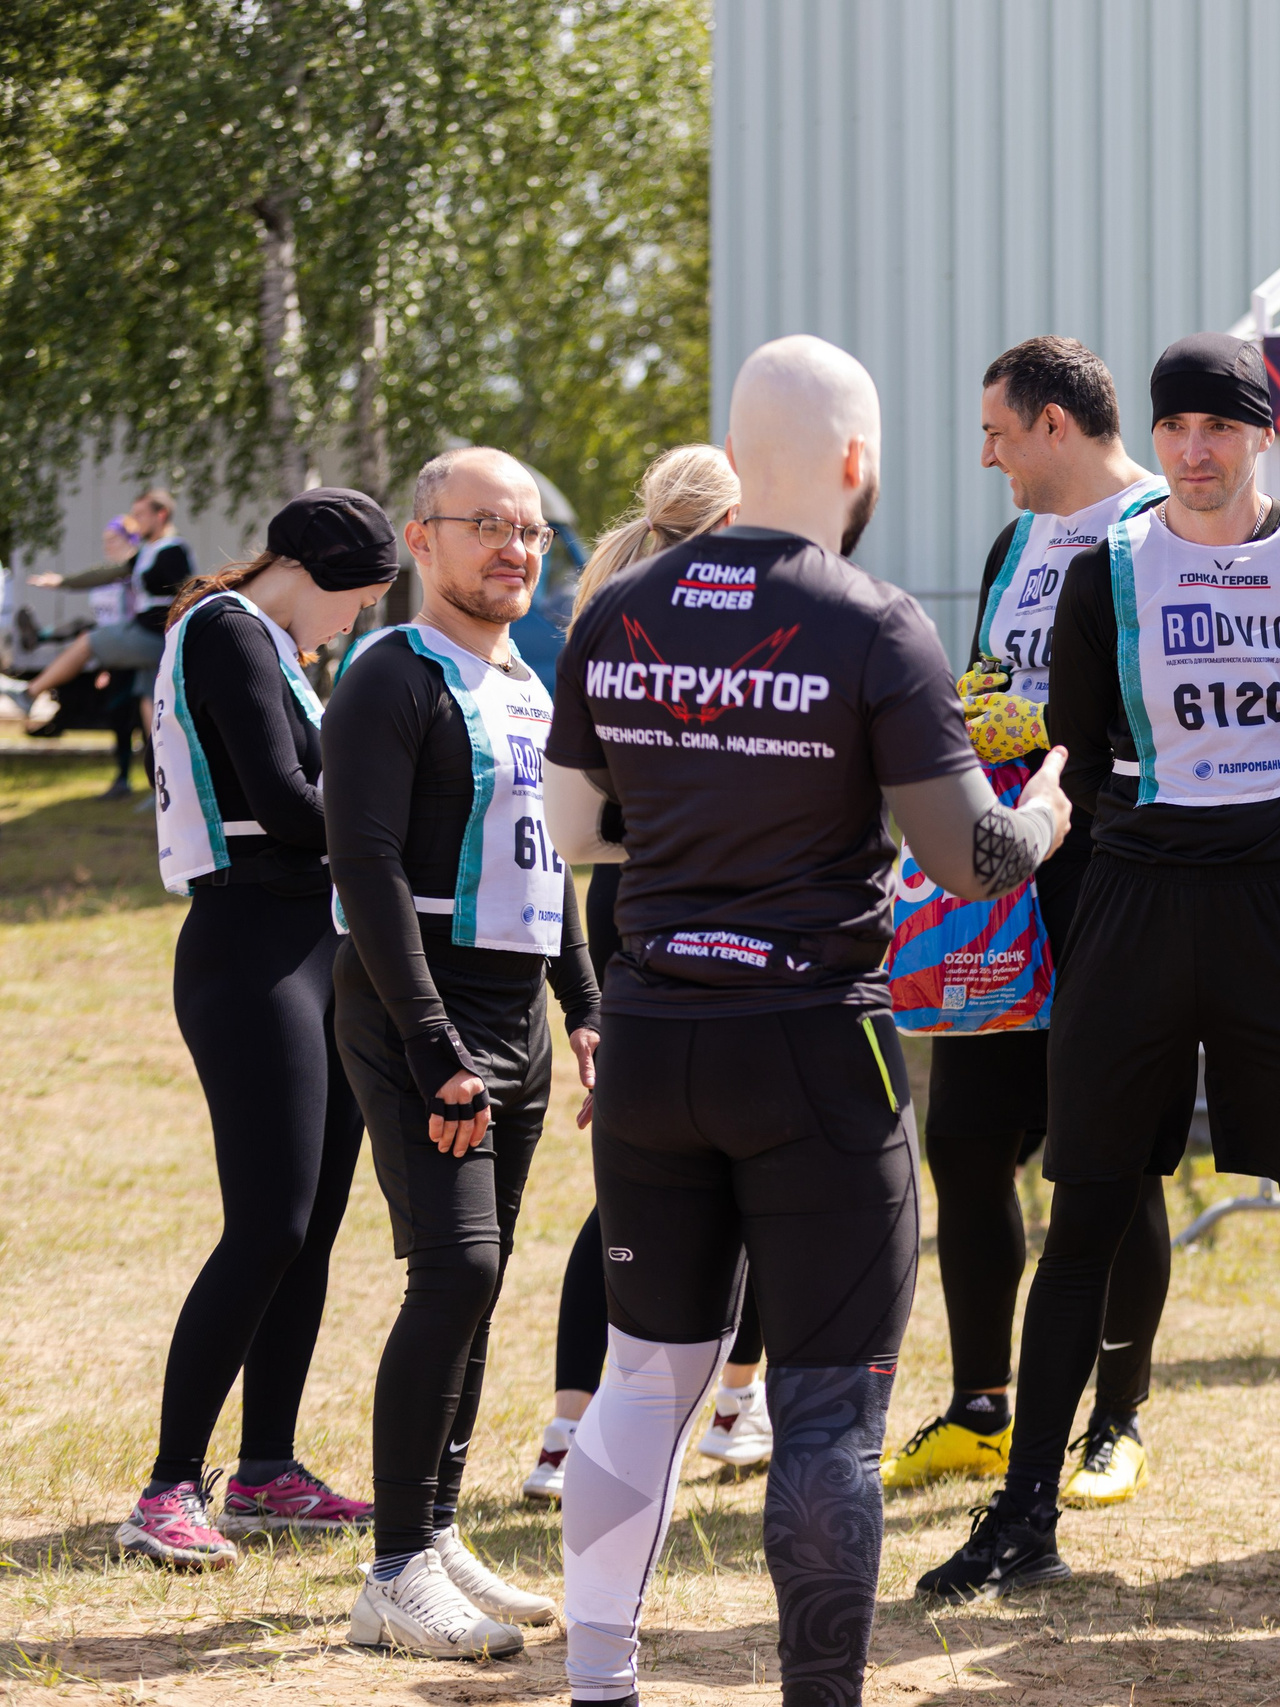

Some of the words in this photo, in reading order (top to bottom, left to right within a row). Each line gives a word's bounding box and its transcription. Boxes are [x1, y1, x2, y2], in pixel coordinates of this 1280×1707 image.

[685, 562, 756, 585] ГОНКА
[1180, 572, 1218, 585] ГОНКА
[1221, 575, 1269, 586] ГЕРОЕВ
[671, 586, 755, 610] ГЕРОЕВ
[585, 660, 830, 713] ИНСТРУКТОР
[506, 705, 531, 716] ГОНКА
[727, 736, 835, 758] НАДЕЖНОСТЬ
[673, 931, 773, 951] ИНСТРУКТОР
[666, 942, 709, 957] ГОНКА
[711, 946, 767, 968] ГЕРОЕВ
[944, 952, 985, 965] ozon
[987, 949, 1025, 965] банк
